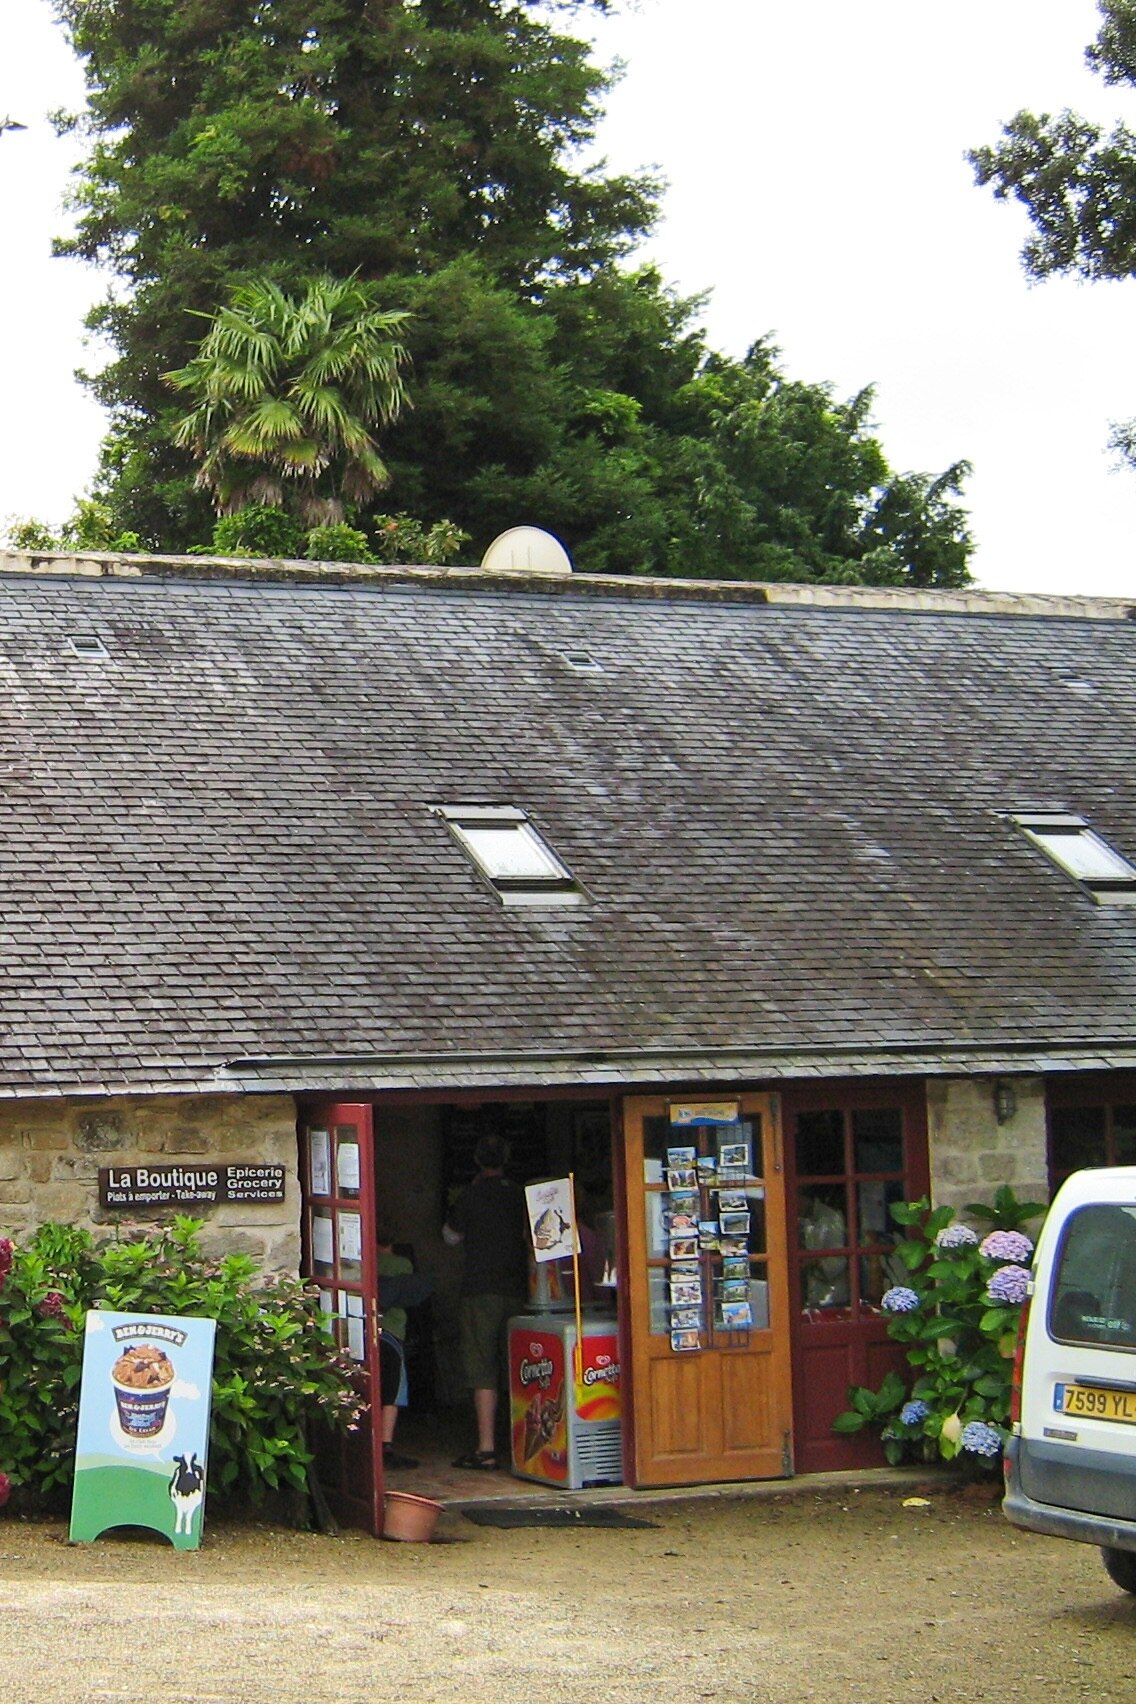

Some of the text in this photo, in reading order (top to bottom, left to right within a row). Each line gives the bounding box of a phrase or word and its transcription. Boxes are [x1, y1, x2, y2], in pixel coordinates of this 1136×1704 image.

[109, 1168, 218, 1191] La Boutique
[227, 1167, 283, 1180] Epicerie
[227, 1178, 282, 1190] Grocery
[135, 1191, 171, 1203] emporter
[227, 1190, 283, 1199] Services
[1066, 1389, 1133, 1417] 7599 YL
